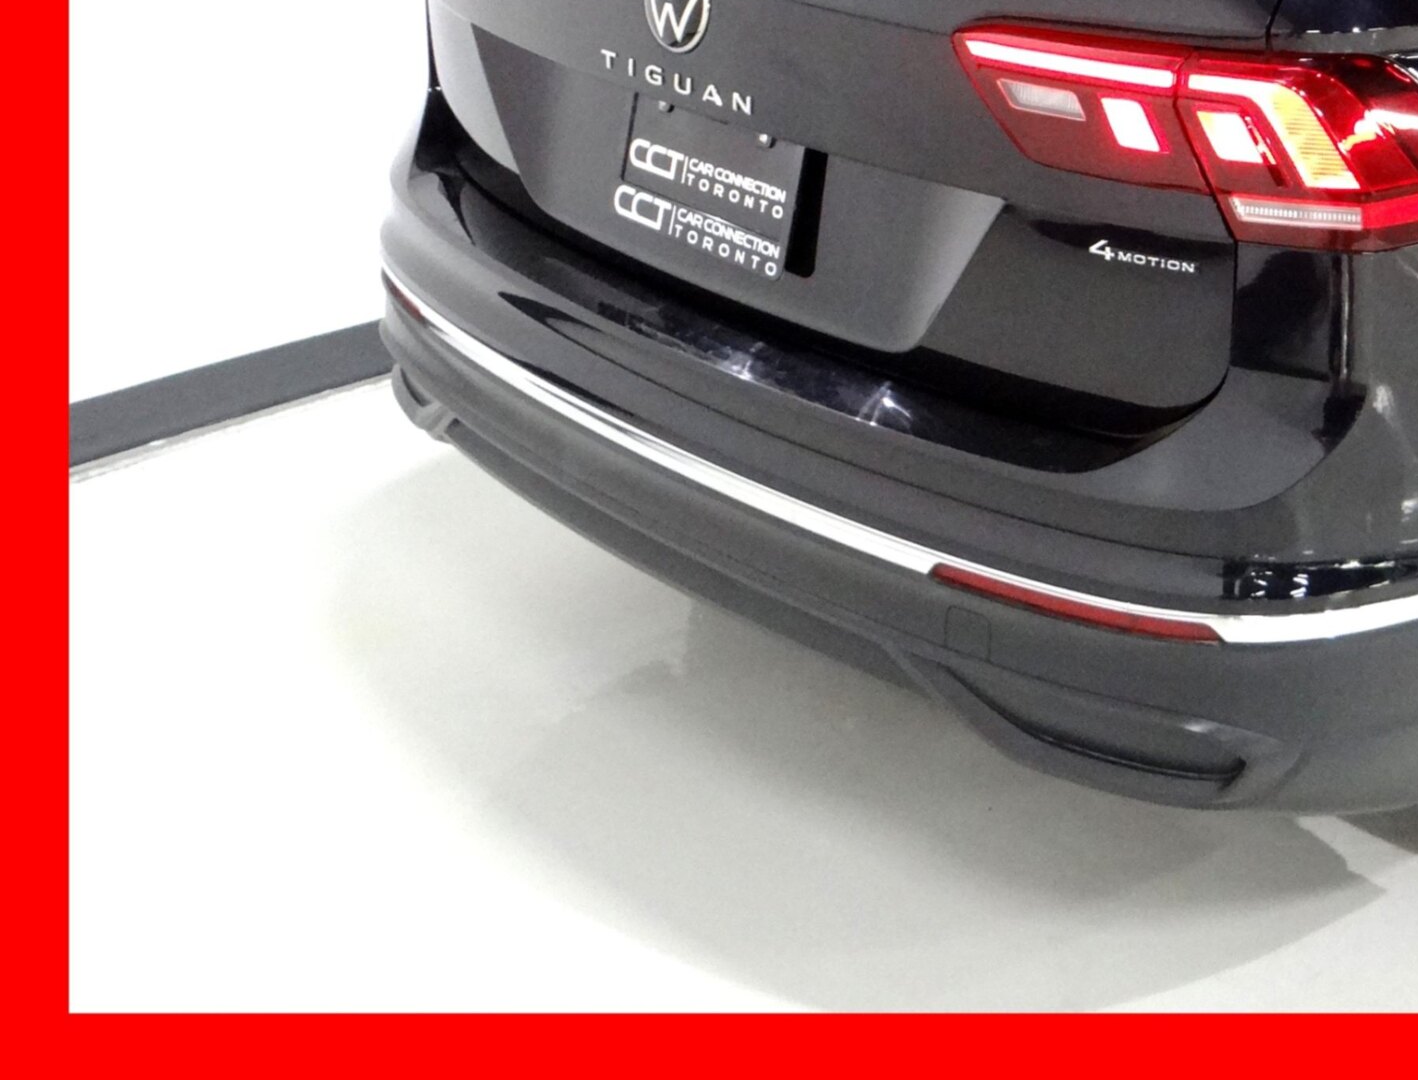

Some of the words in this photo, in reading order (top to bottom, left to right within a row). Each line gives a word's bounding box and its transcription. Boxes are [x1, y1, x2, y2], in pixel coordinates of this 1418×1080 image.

[600, 48, 755, 116] TIGUAN
[629, 138, 685, 181] CCT
[689, 157, 714, 177] CAR
[714, 167, 787, 204] CONNECTION
[613, 184, 672, 231] CCT
[685, 172, 784, 220] TORONTO
[674, 224, 778, 277] TORONTO
[677, 207, 703, 229] CAR
[703, 218, 781, 259] CONNECTION
[1088, 239, 1196, 273] 4MOTION
